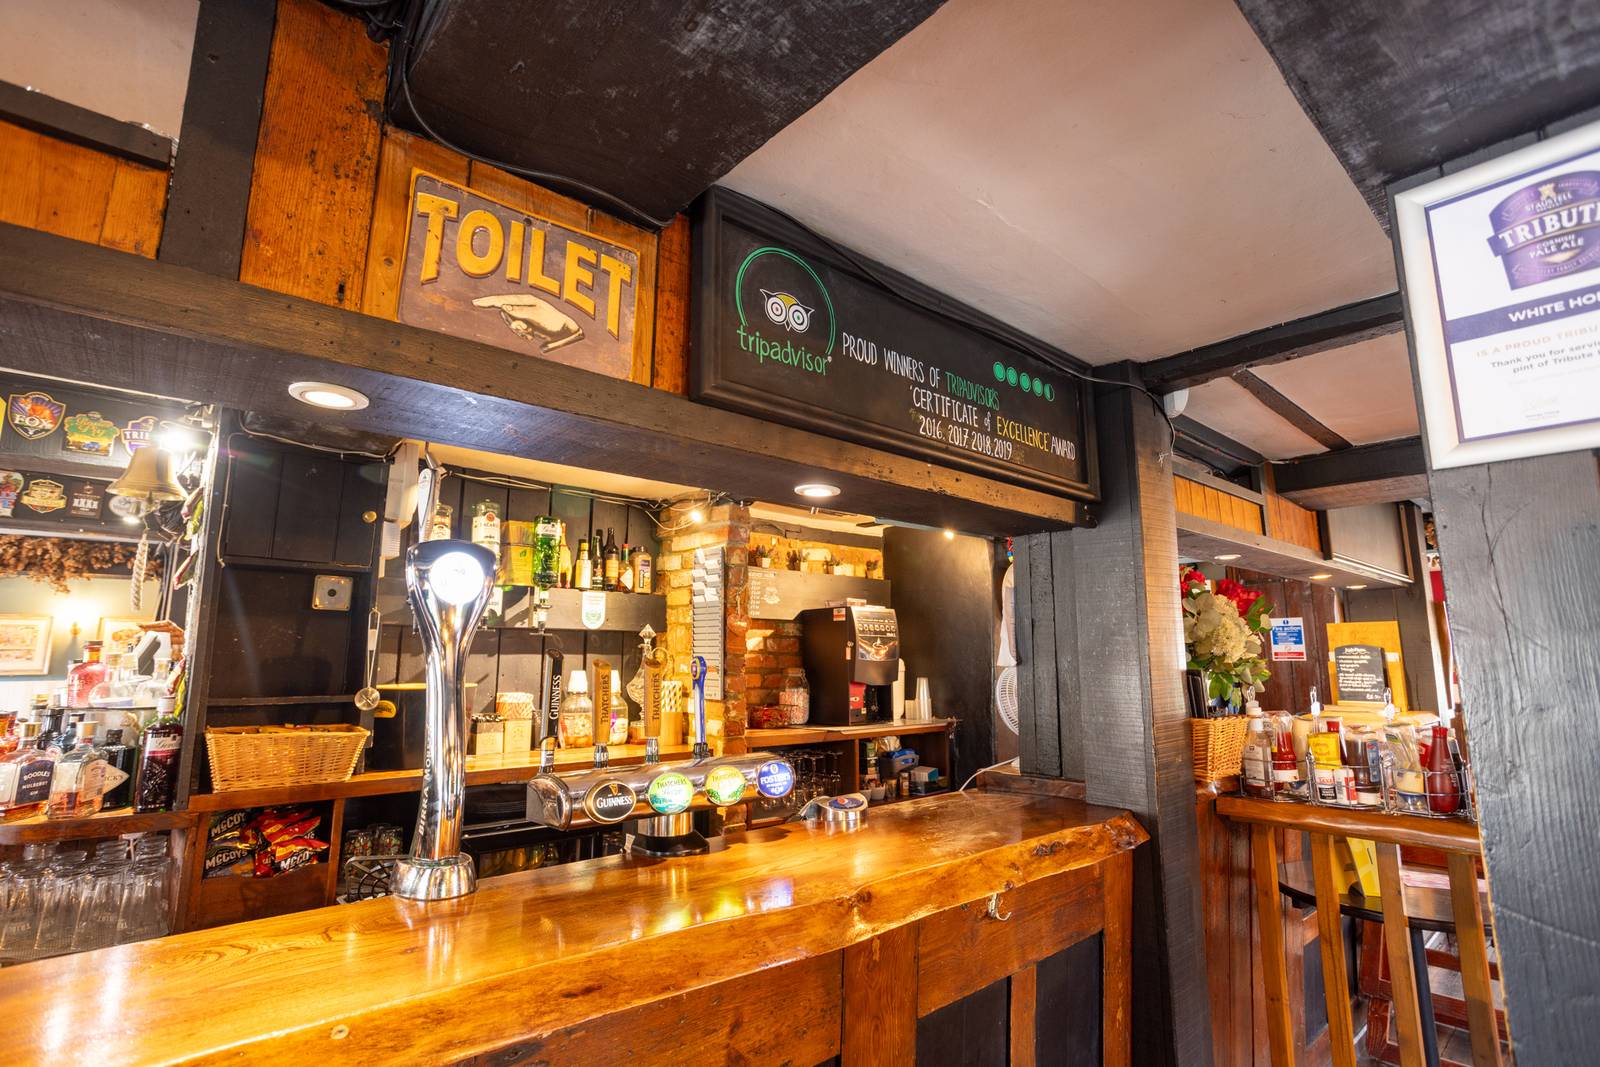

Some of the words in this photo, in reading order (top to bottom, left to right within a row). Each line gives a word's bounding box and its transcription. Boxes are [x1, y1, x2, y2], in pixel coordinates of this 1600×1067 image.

[1529, 244, 1558, 259] PALE
[1560, 238, 1584, 250] ALE
[417, 192, 632, 340] TOILET
[1508, 301, 1565, 322] WHITE
[736, 324, 828, 376] tripadvisor
[1505, 335, 1551, 351] PROUD
[842, 332, 878, 366] PROUD
[884, 347, 925, 383] WINNERS
[930, 366, 941, 388] OF
[1491, 357, 1521, 368] Thank
[1526, 352, 1546, 364] you
[1549, 348, 1565, 359] for
[1513, 363, 1534, 374] pint
[1538, 358, 1549, 368] of
[1553, 352, 1593, 365] Tribute
[14, 412, 54, 430] FOX
[1050, 436, 1076, 461] AWARD
[548, 674, 562, 720] GUINNESS
[601, 674, 609, 724] THATCHERS
[652, 672, 660, 720] THATCHERS
[596, 796, 632, 810] GUINNESS
